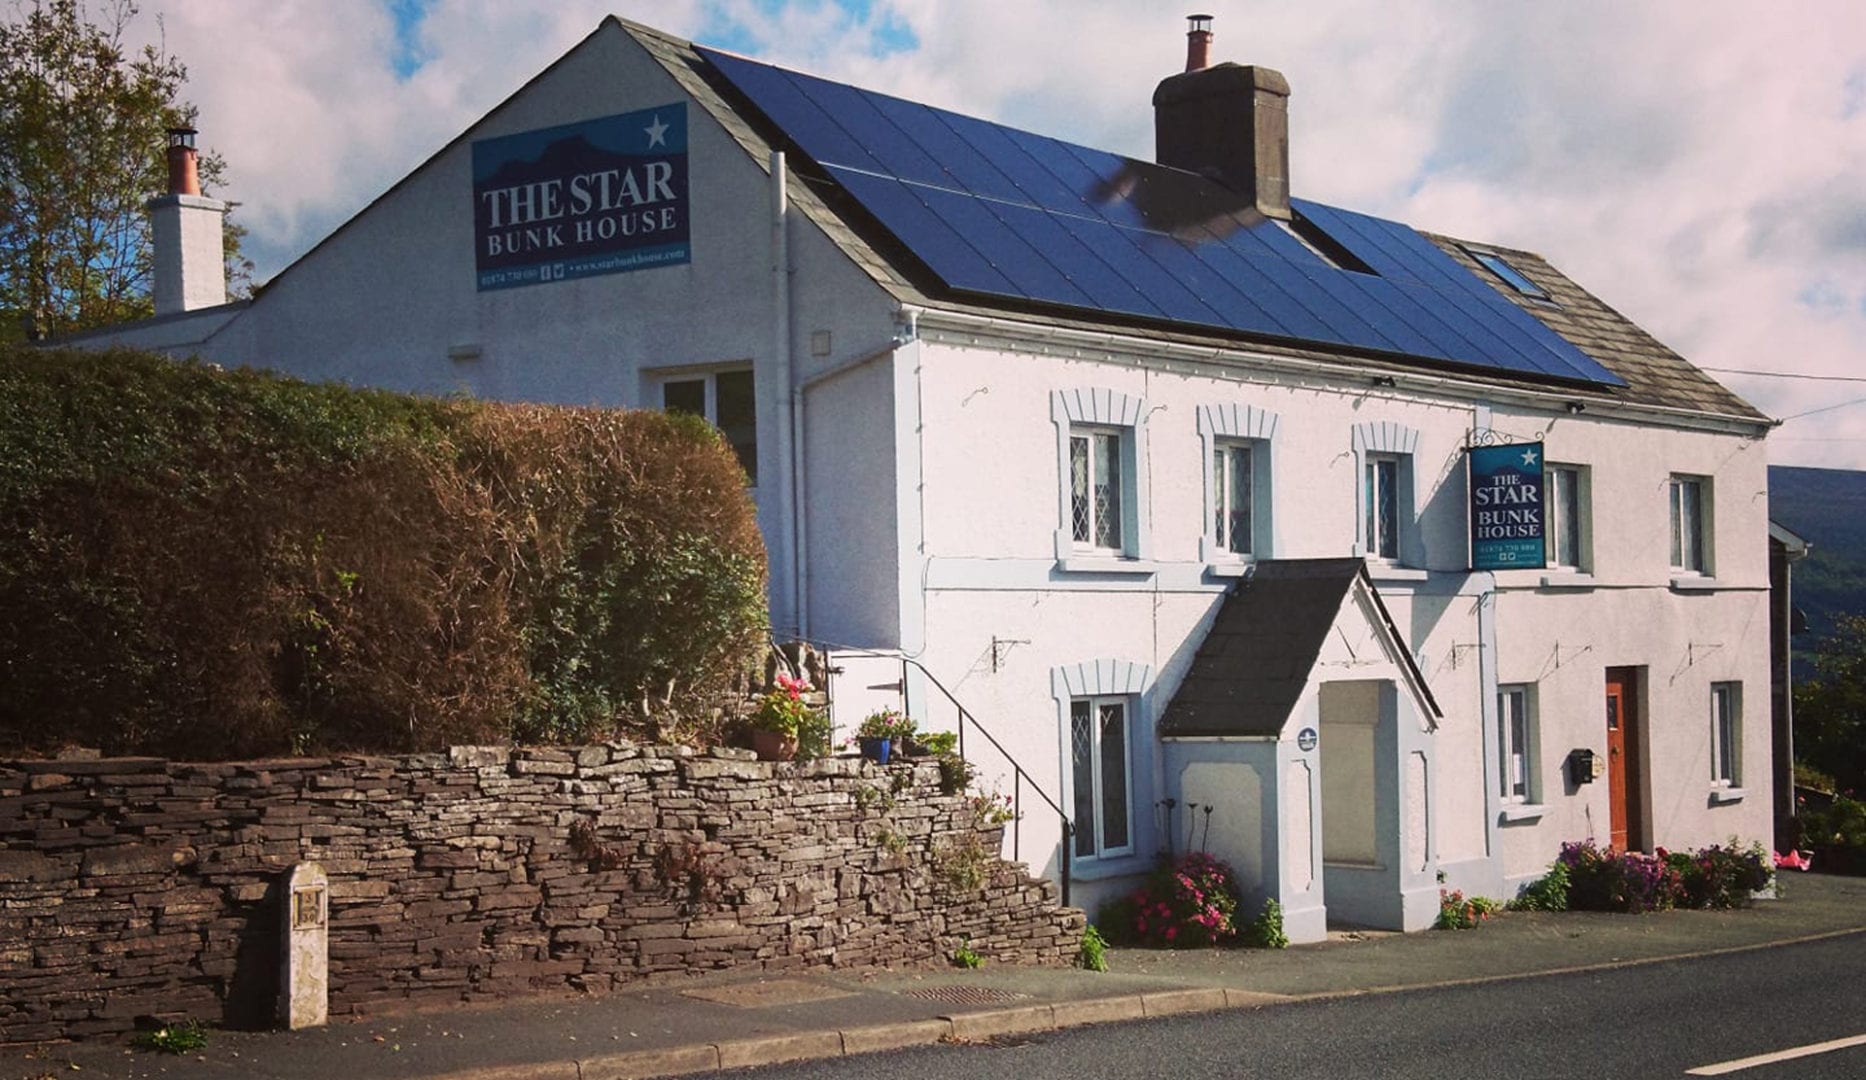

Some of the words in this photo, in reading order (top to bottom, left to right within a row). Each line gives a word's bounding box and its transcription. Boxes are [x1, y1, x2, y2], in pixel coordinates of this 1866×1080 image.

[483, 178, 565, 229] THE
[570, 161, 677, 216] STAR
[487, 225, 565, 256] BUNK
[576, 207, 677, 243] HOUSE
[1492, 474, 1521, 486] THE
[1475, 484, 1539, 505] STAR
[1478, 508, 1540, 525] BUNK
[1477, 524, 1540, 539] HOUSE
